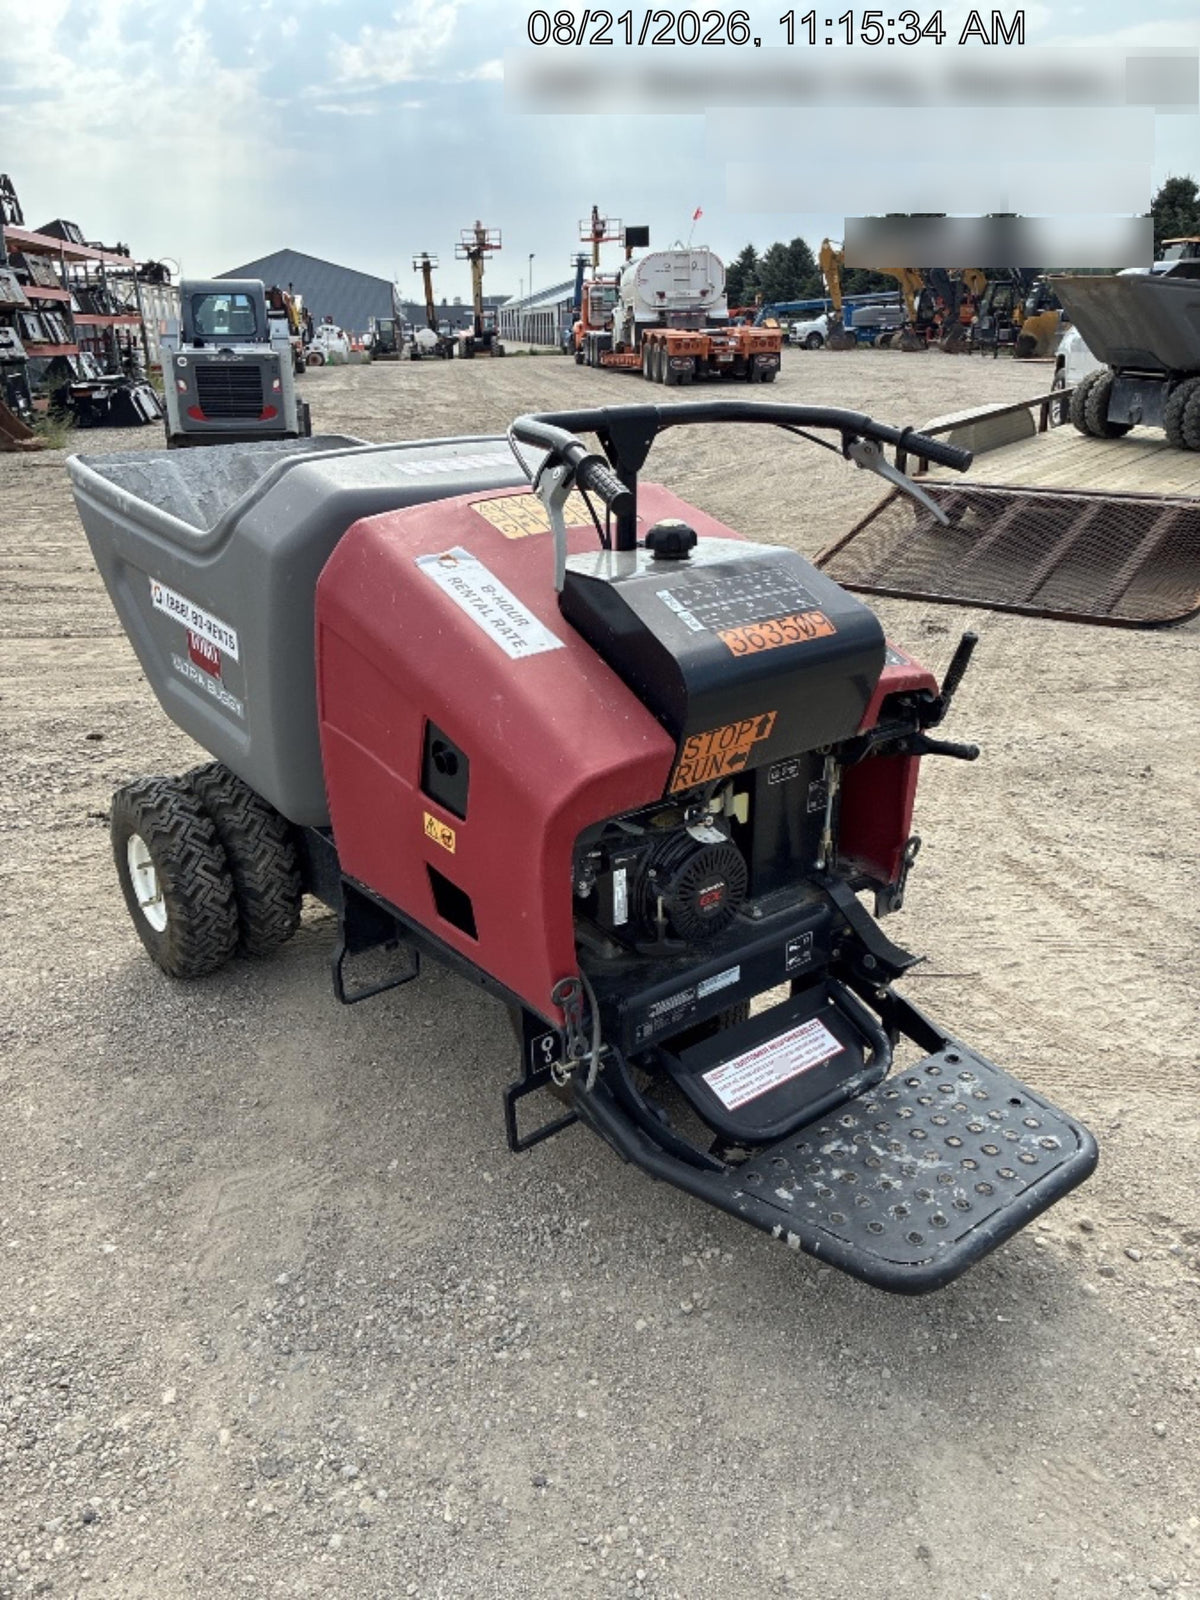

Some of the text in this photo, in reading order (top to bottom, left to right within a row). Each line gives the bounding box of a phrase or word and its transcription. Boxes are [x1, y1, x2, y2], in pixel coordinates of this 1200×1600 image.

[447, 577, 529, 648] RENTAL RATE
[684, 719, 754, 759] STOP
[673, 751, 726, 788] RUN
